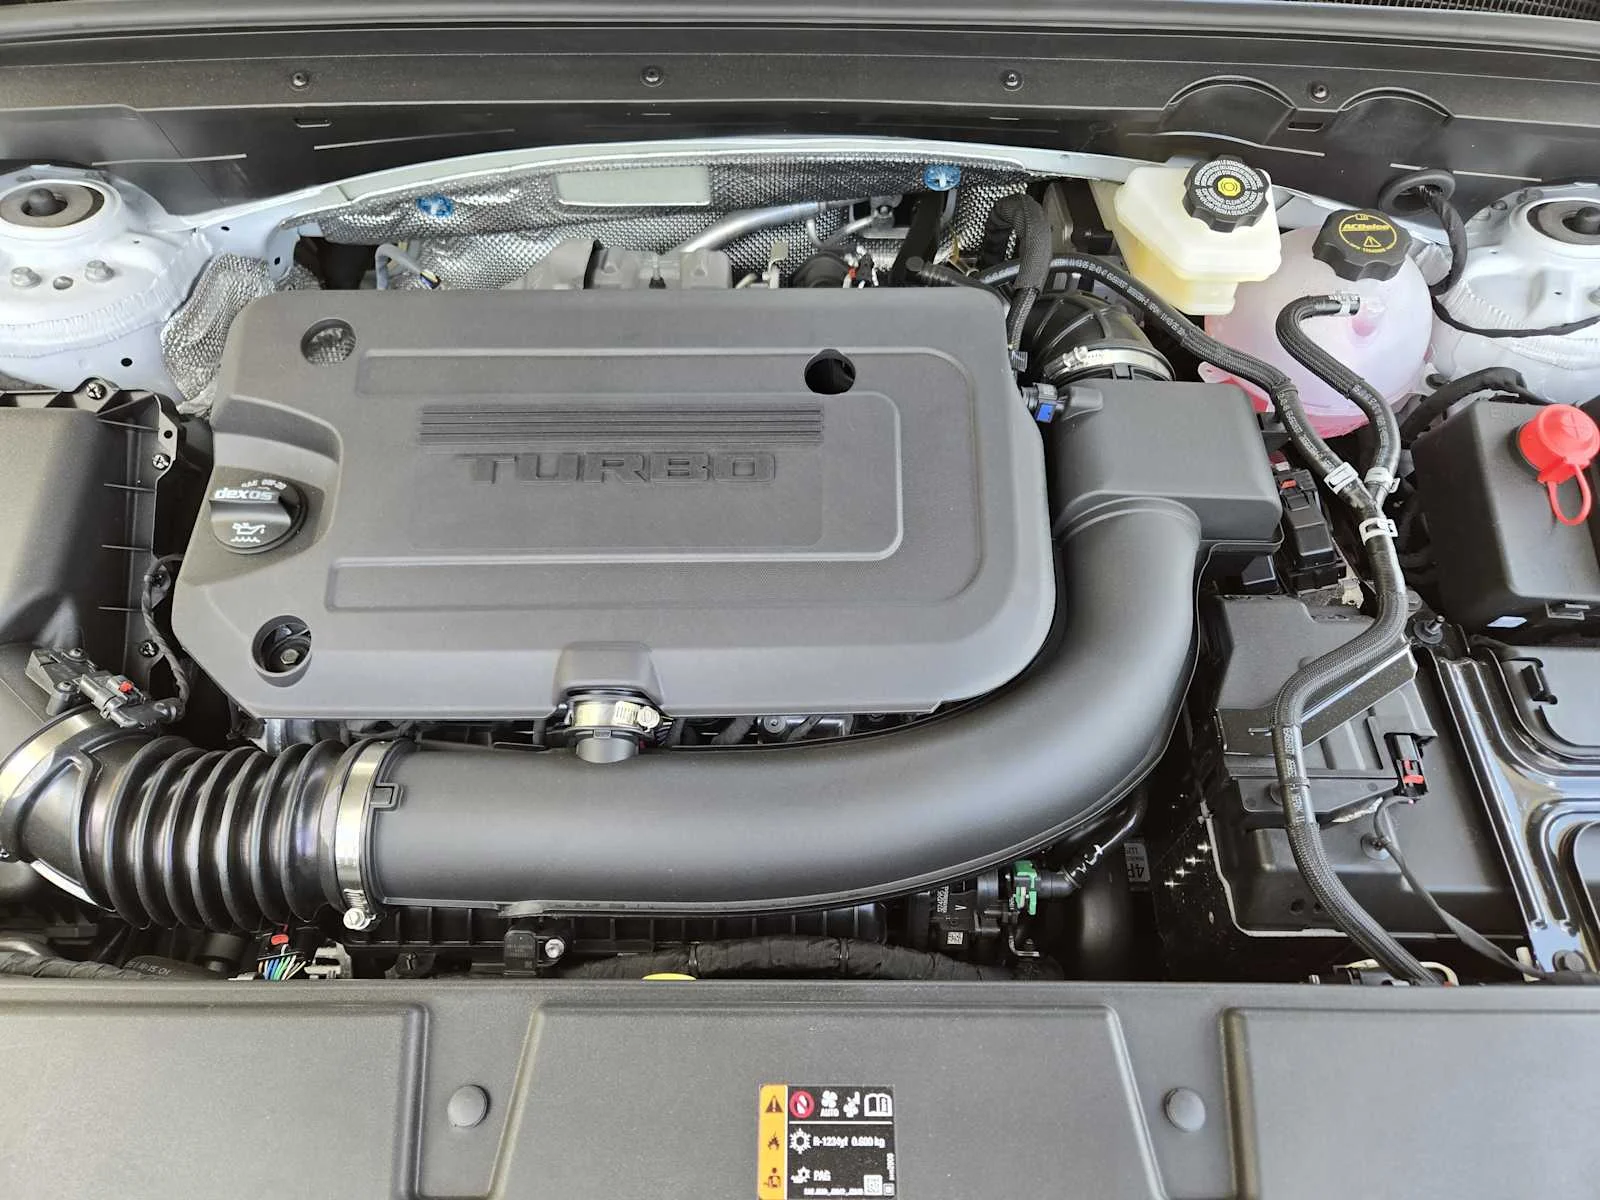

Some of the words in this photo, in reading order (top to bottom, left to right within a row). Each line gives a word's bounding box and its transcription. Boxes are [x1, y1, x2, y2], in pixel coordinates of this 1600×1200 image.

[457, 451, 776, 483] TURBO
[214, 487, 273, 500] dexos
[813, 1170, 831, 1182] PAG
